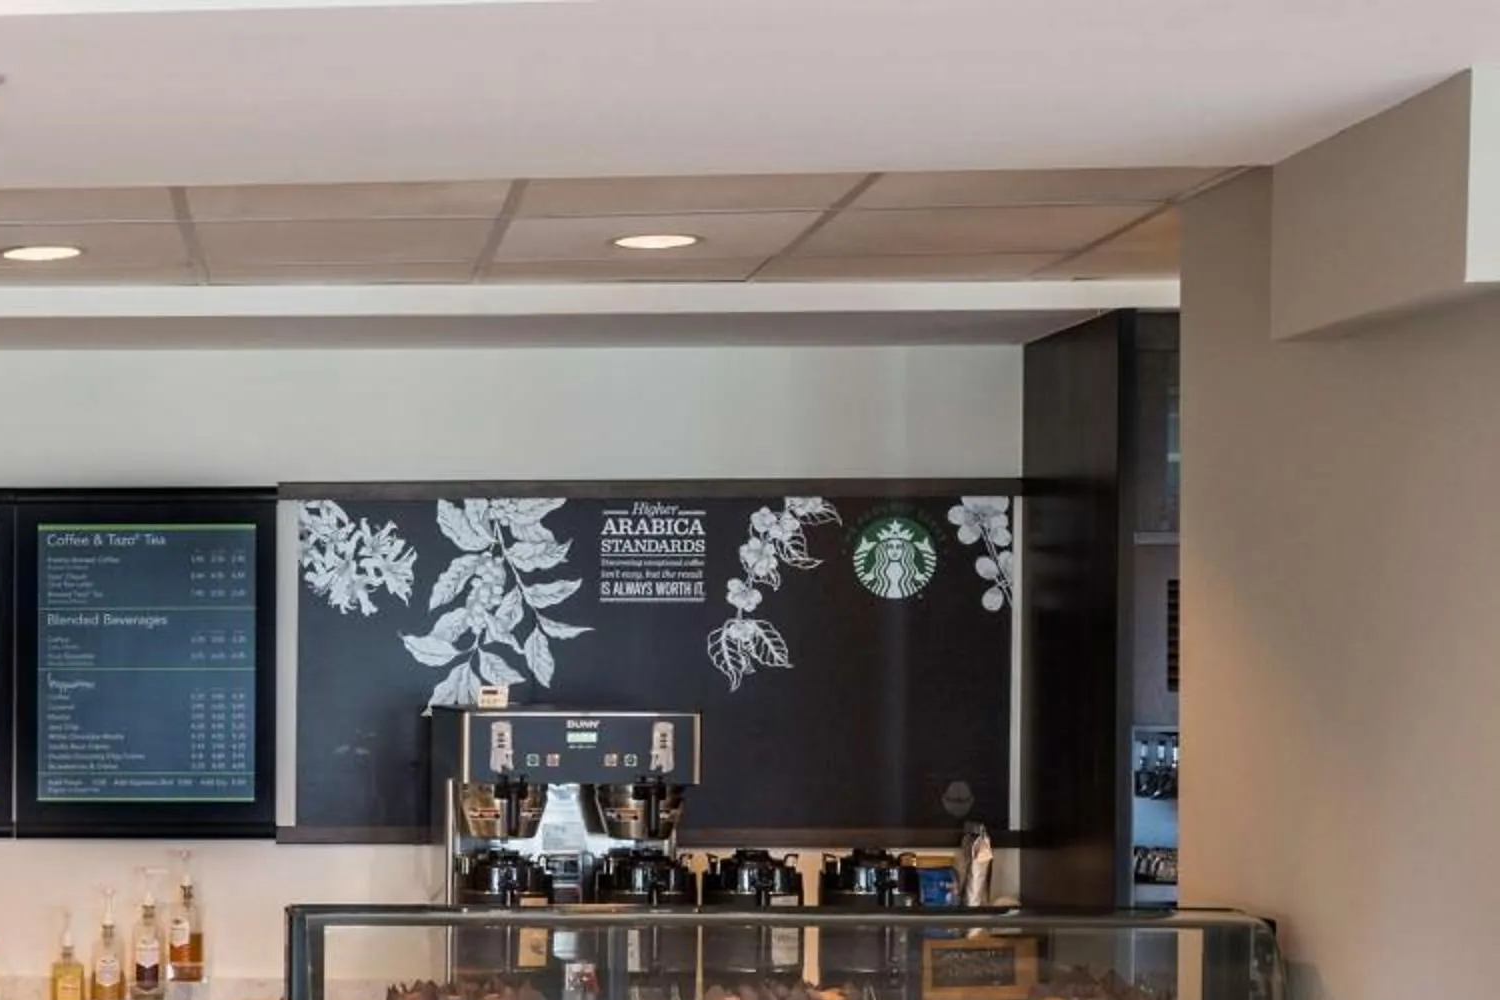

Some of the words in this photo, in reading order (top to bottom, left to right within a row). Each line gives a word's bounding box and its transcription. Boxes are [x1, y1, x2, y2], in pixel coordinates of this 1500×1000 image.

[631, 501, 679, 518] Higher
[601, 518, 706, 536] ARABICA
[47, 533, 90, 546] Coffee
[93, 534, 103, 546] &
[143, 534, 167, 546] Tea
[601, 539, 705, 553] STANDARDS
[601, 581, 611, 595] IS
[613, 581, 653, 596] ALWAYS
[655, 581, 691, 596] WORTH
[47, 613, 99, 626] Blended
[103, 613, 168, 629] Beverages
[567, 719, 600, 729] BUNN
